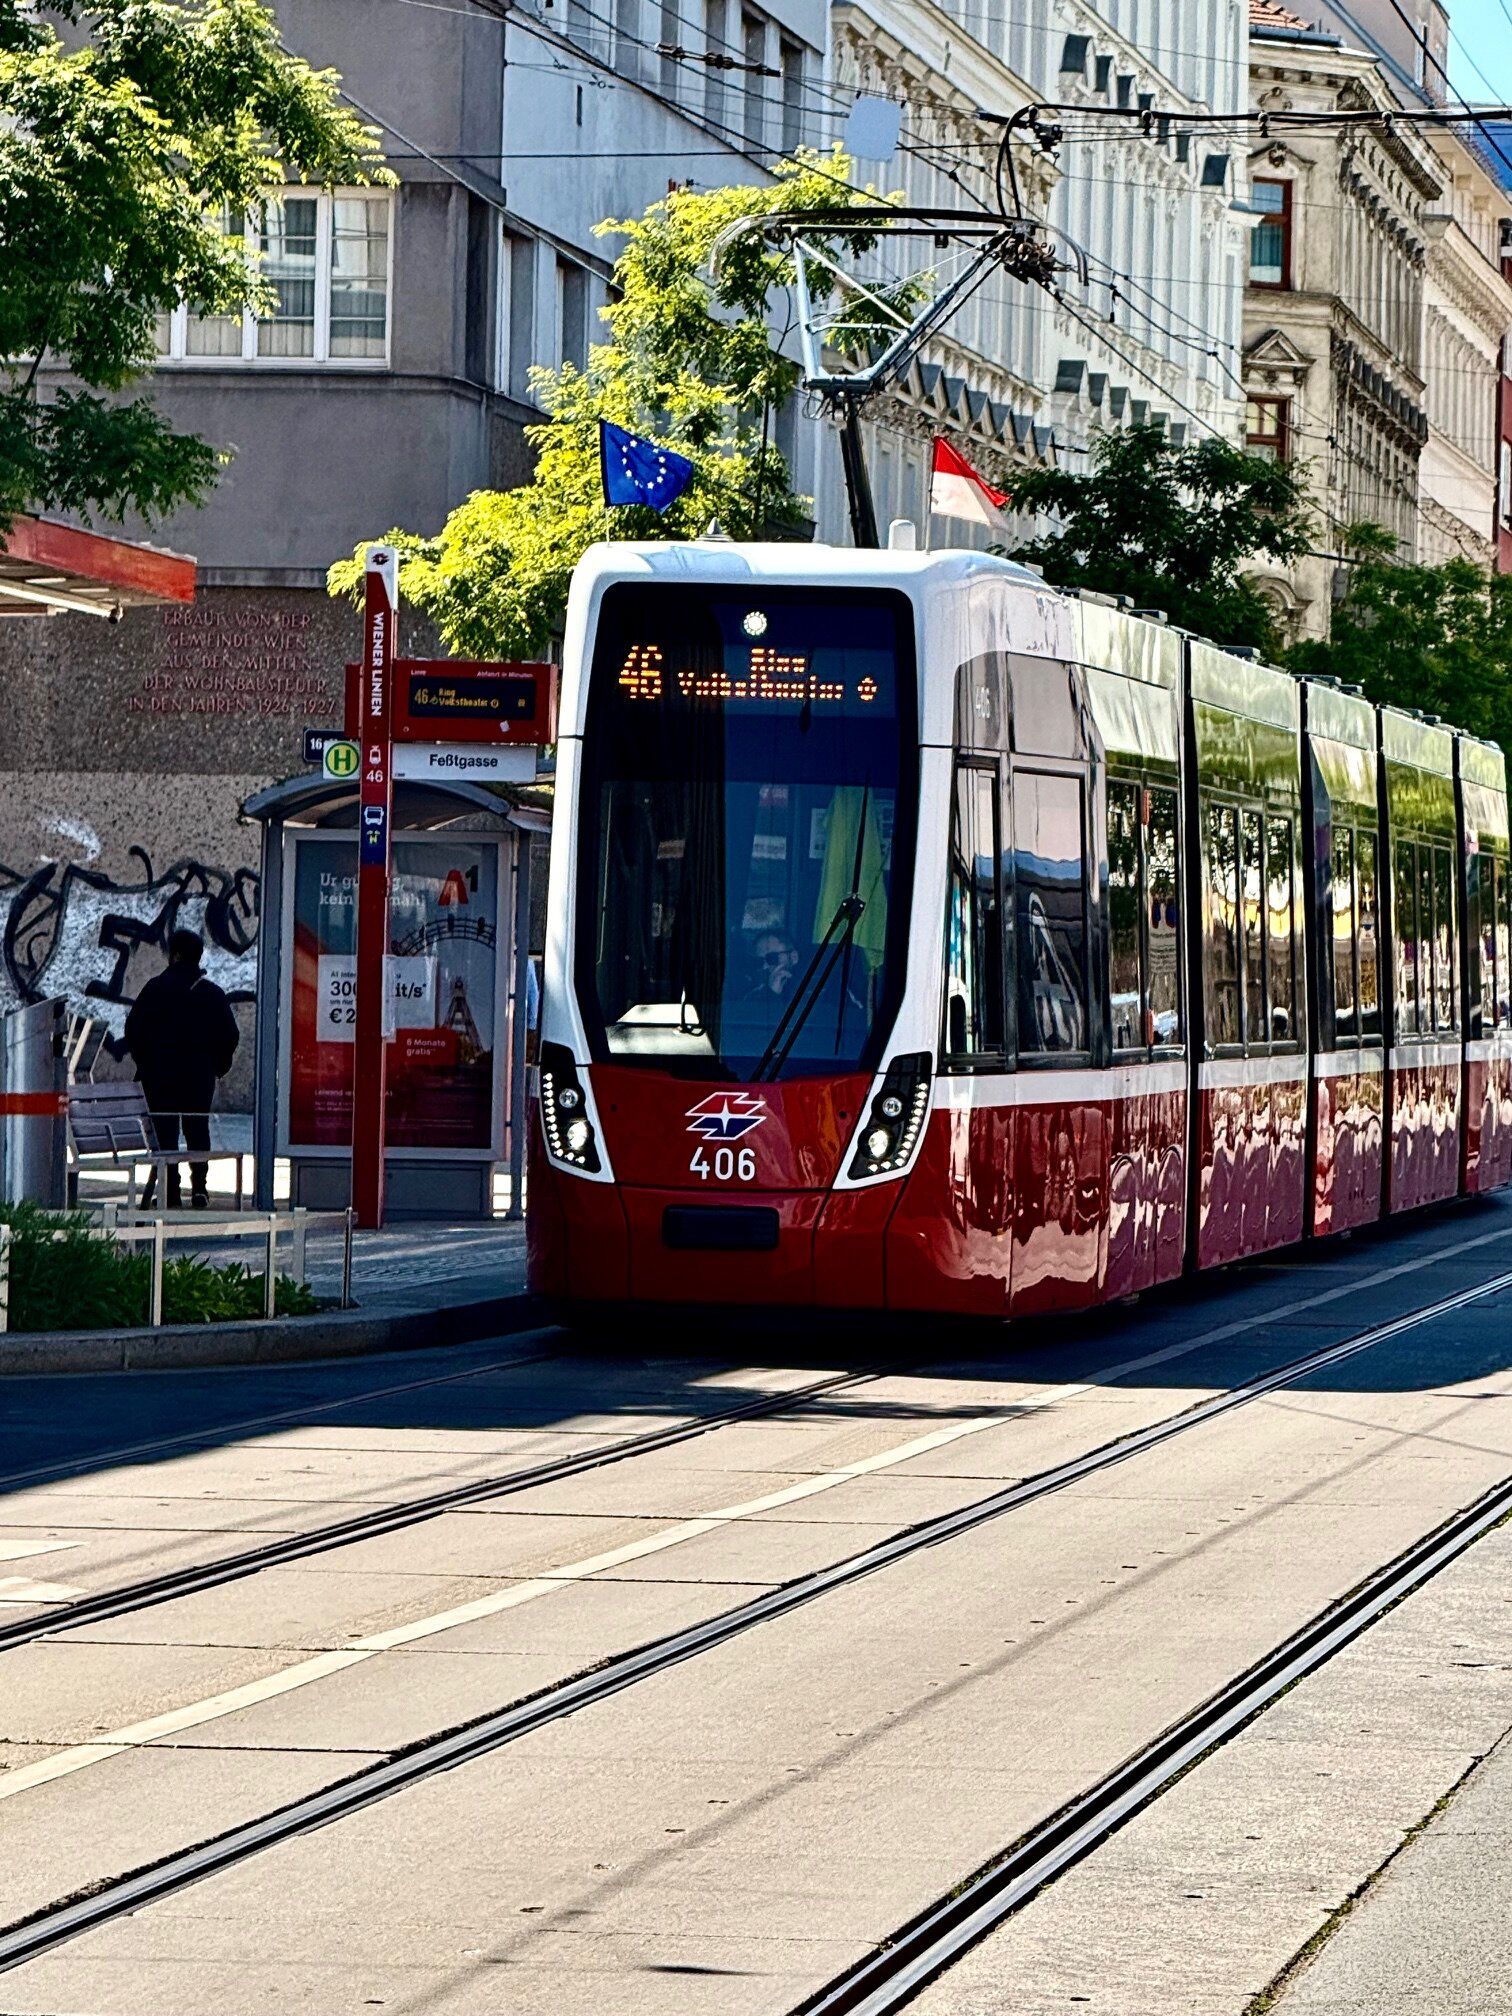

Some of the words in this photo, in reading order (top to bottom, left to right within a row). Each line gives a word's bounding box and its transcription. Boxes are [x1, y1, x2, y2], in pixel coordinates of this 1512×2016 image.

[164, 611, 222, 626] ERBAUT
[235, 612, 271, 626] VON
[281, 614, 311, 628] DER
[166, 632, 249, 648] GEMEINDE
[264, 634, 306, 649] WIEN
[373, 611, 385, 667] WIENER
[163, 654, 192, 669] AUS
[201, 655, 233, 669] DEN
[618, 646, 662, 699] 46
[145, 676, 174, 690] DER
[185, 676, 326, 693] WOHNBAUSTEUER
[371, 669, 383, 716] LINIEN
[415, 688, 428, 704] 46
[439, 688, 455, 698] Ring
[440, 698, 488, 707] Volkstheater
[129, 698, 144, 711] IN
[151, 698, 182, 712] DEN
[188, 698, 246, 713] JAHREN
[258, 699, 289, 713] 1926
[303, 699, 336, 714] 1927
[334, 749, 351, 771] H
[429, 753, 499, 769] Feßtgasse
[366, 770, 383, 783] 46
[320, 872, 337, 887] Ur
[438, 865, 479, 907] A1
[320, 892, 354, 906] kein
[414, 1039, 446, 1047] Monate
[690, 1146, 756, 1181] 406
